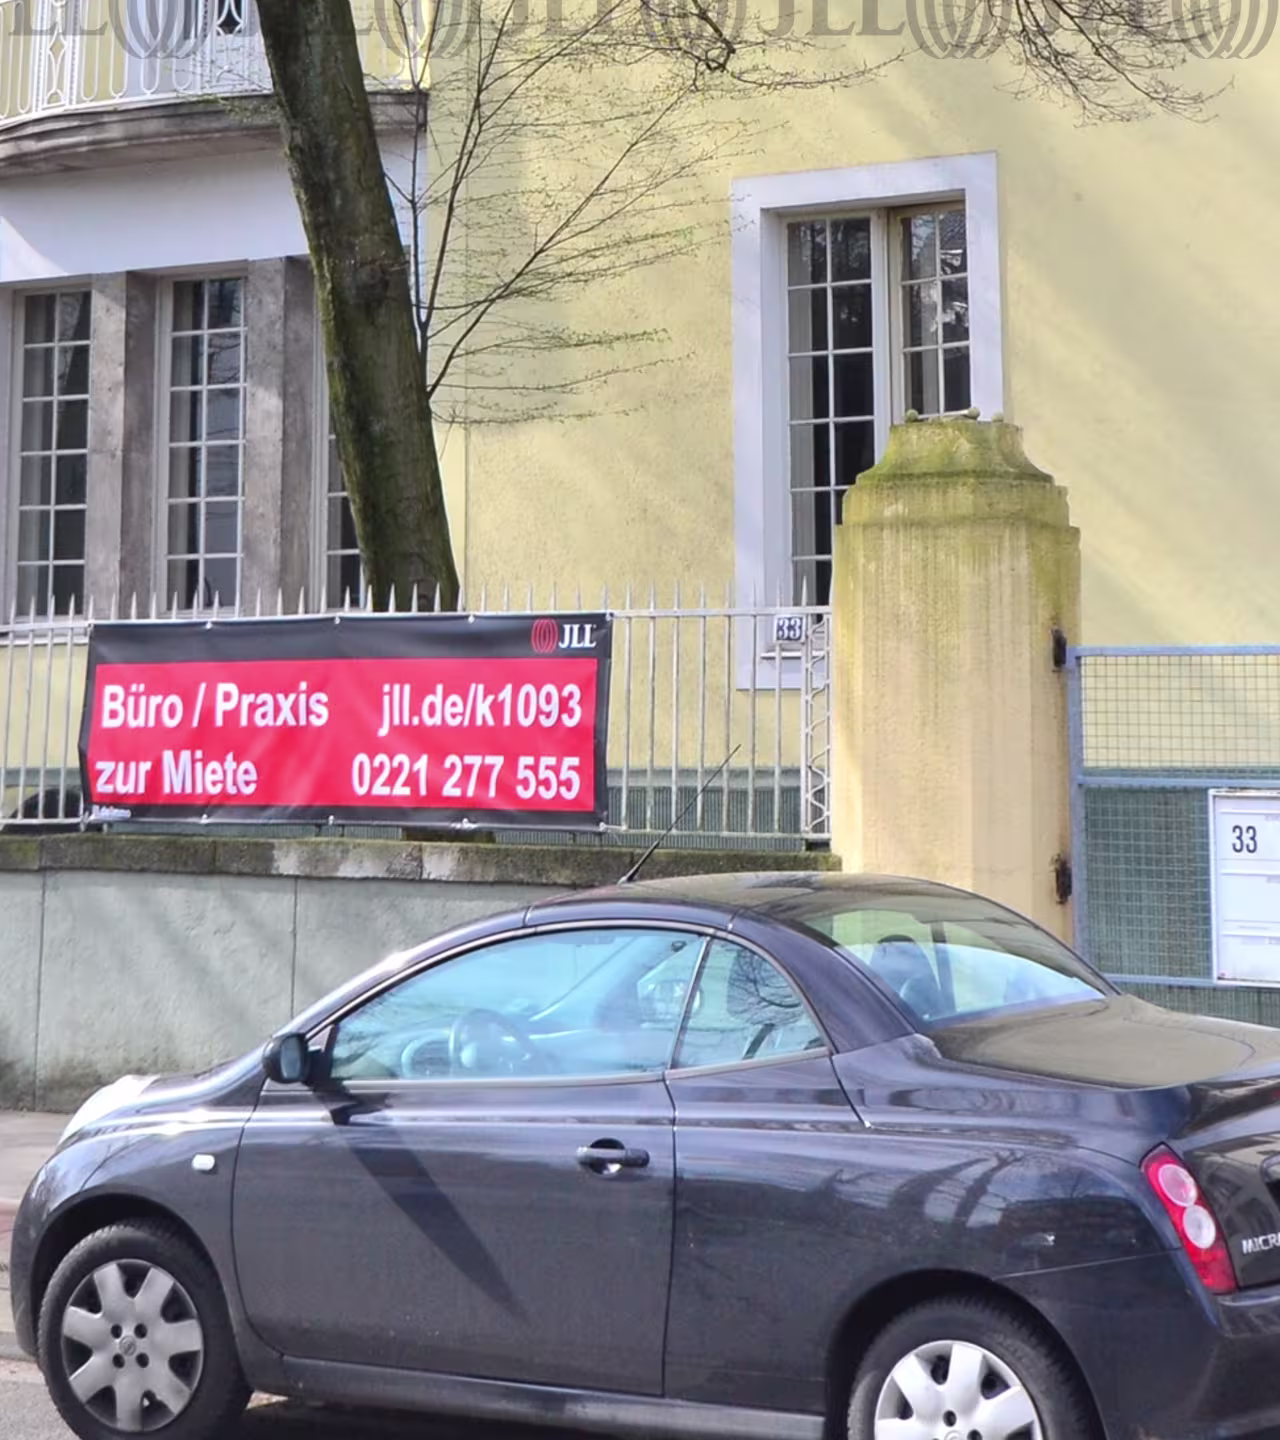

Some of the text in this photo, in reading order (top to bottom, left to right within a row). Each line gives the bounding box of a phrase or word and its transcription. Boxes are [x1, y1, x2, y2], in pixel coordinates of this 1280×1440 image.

[558, 624, 596, 648] JLL
[777, 617, 801, 639] 33
[101, 681, 329, 729] Büro / Praxis
[377, 683, 582, 737] jll.de/k1093
[95, 749, 258, 795] zur Miete
[352, 753, 581, 800] 0221 277 555
[1232, 825, 1258, 854] 33
